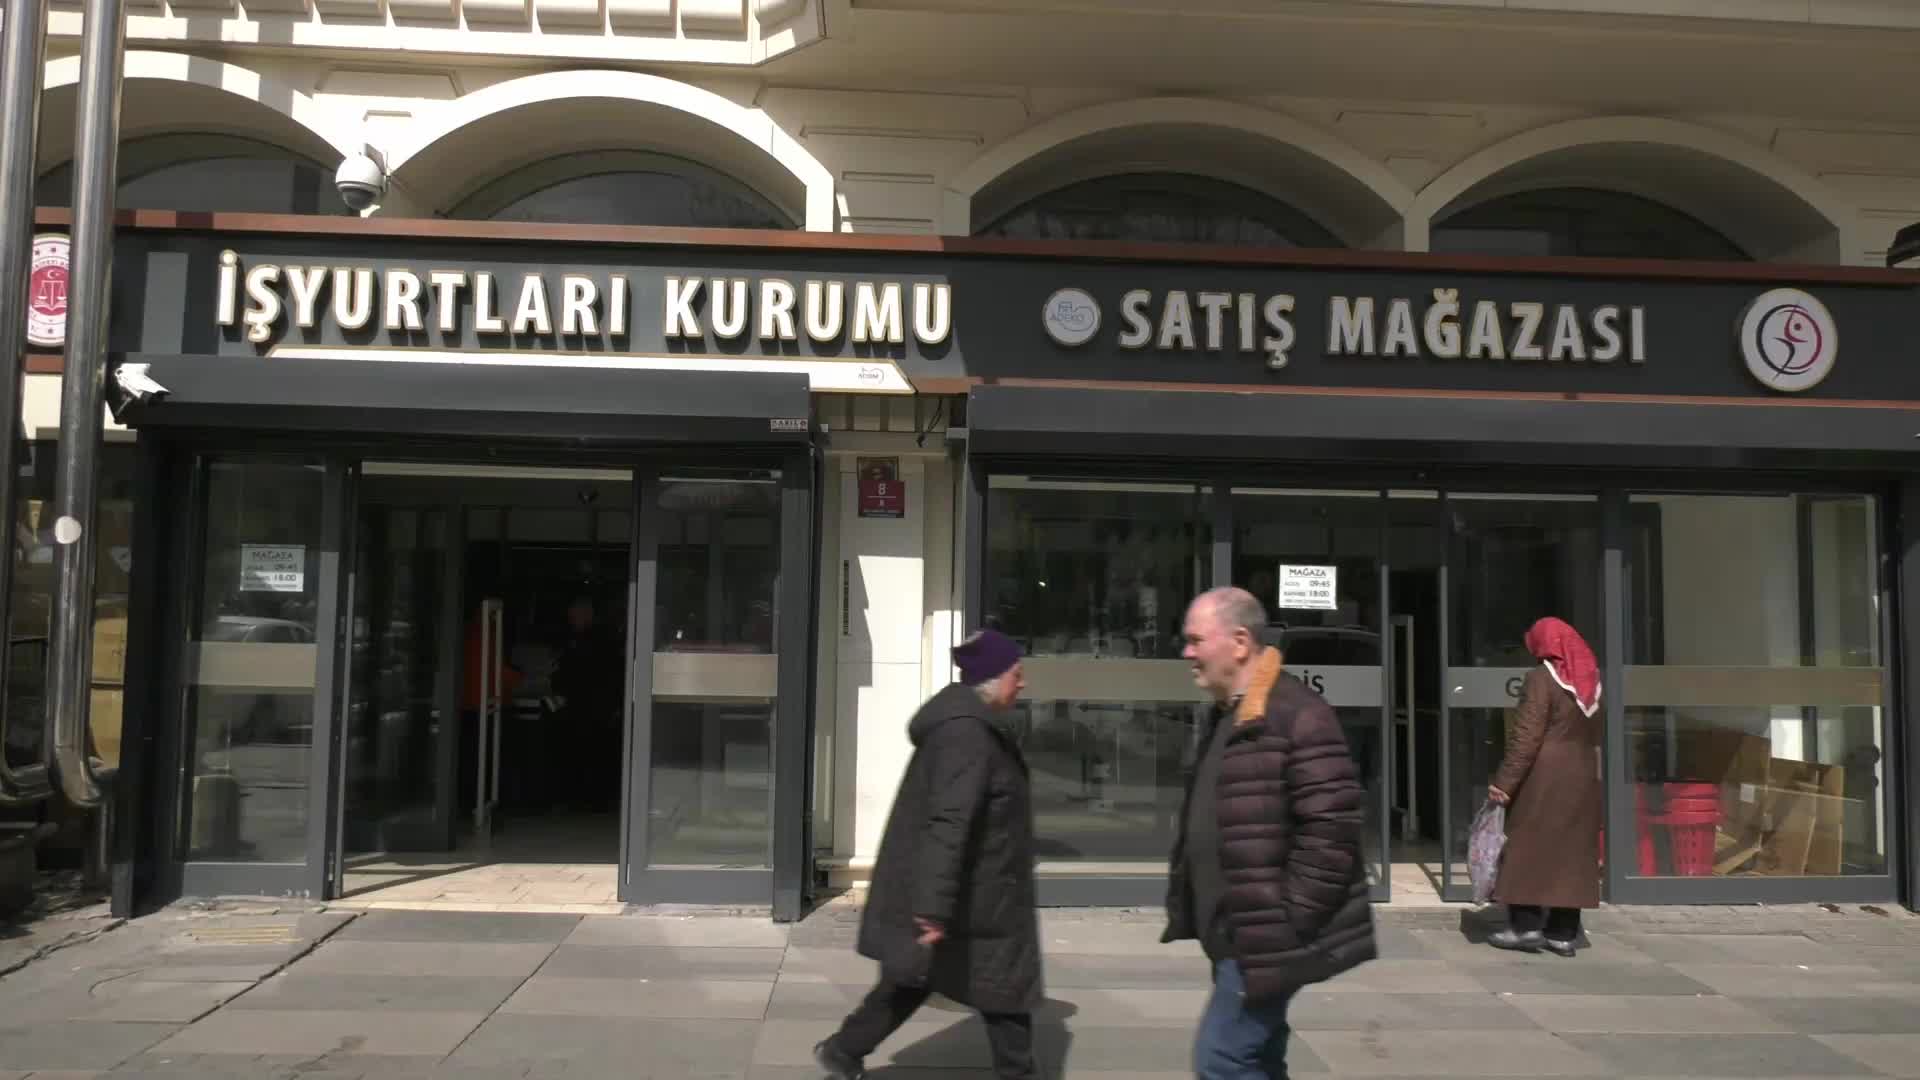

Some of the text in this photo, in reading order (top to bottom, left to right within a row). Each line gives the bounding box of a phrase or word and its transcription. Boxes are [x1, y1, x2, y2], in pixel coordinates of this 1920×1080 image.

[216, 249, 951, 344] İŞYURTLARI KURUMU
[1118, 287, 1648, 367] SATIŞ MAĞAZASI
[1289, 568, 1326, 576] MAĞAZA
